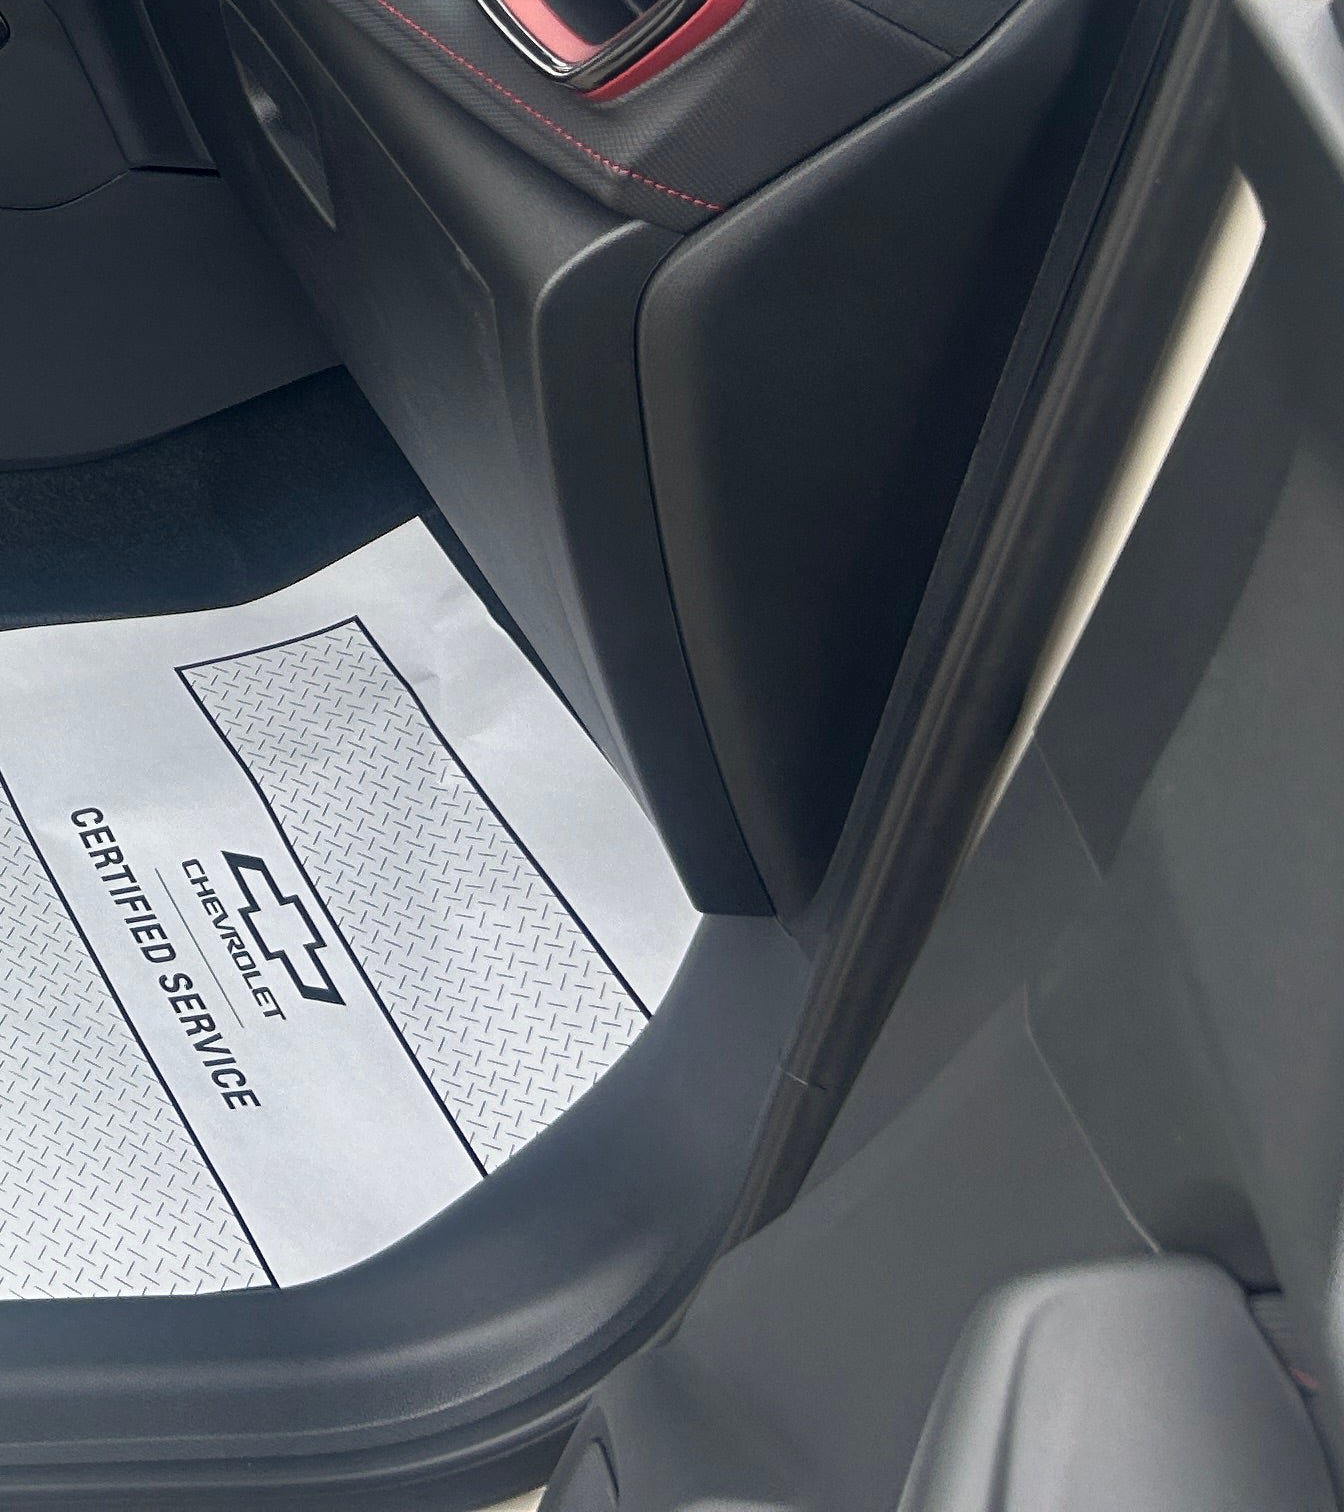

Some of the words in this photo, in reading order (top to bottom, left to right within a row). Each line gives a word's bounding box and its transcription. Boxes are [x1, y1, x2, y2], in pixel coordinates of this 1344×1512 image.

[70, 807, 177, 964] CERTIFIED
[158, 972, 262, 1110] SERVICE
[181, 858, 287, 1021] CHEVROLET
